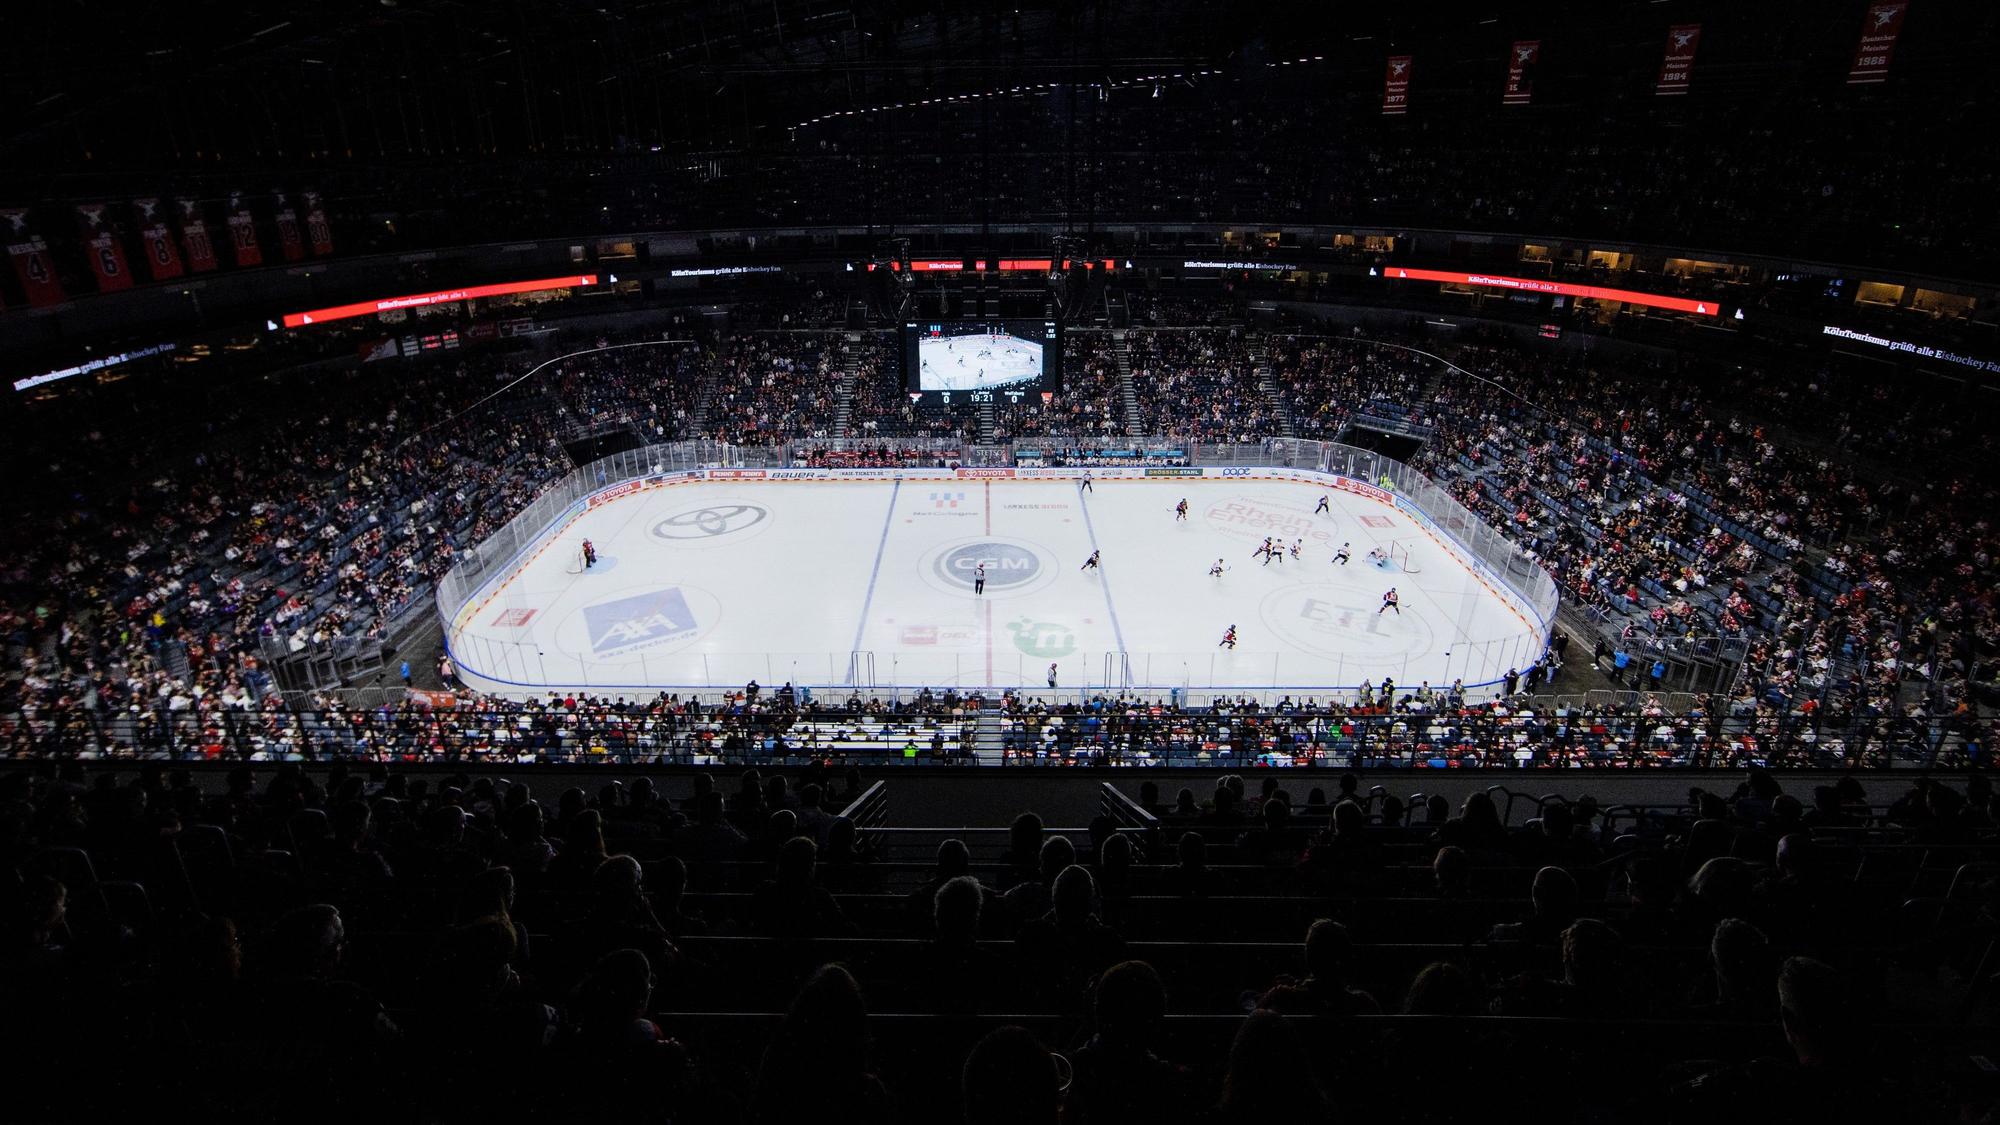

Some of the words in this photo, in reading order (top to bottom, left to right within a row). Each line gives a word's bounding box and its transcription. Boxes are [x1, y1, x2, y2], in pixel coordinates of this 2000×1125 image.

[1860, 35, 1896, 43] Deutscher
[1857, 56, 1886, 66] 1986
[1663, 73, 1687, 81] 1984
[232, 223, 256, 249] 12
[101, 249, 119, 276] 6
[154, 238, 170, 265] 8
[27, 252, 49, 284] 4
[1823, 325, 1890, 347] KölnTourismus
[1890, 339, 1916, 353] grüßt
[1916, 346, 1934, 358] alle
[1935, 349, 1985, 370] Eishockey
[970, 394, 993, 402] 19:21
[606, 484, 633, 498] TOYOTA
[1358, 484, 1385, 498] TOYOTA
[1207, 508, 1332, 540] Energie
[1224, 502, 1313, 528] Rhein
[954, 557, 1030, 570] CGM
[592, 611, 680, 650] AXA
